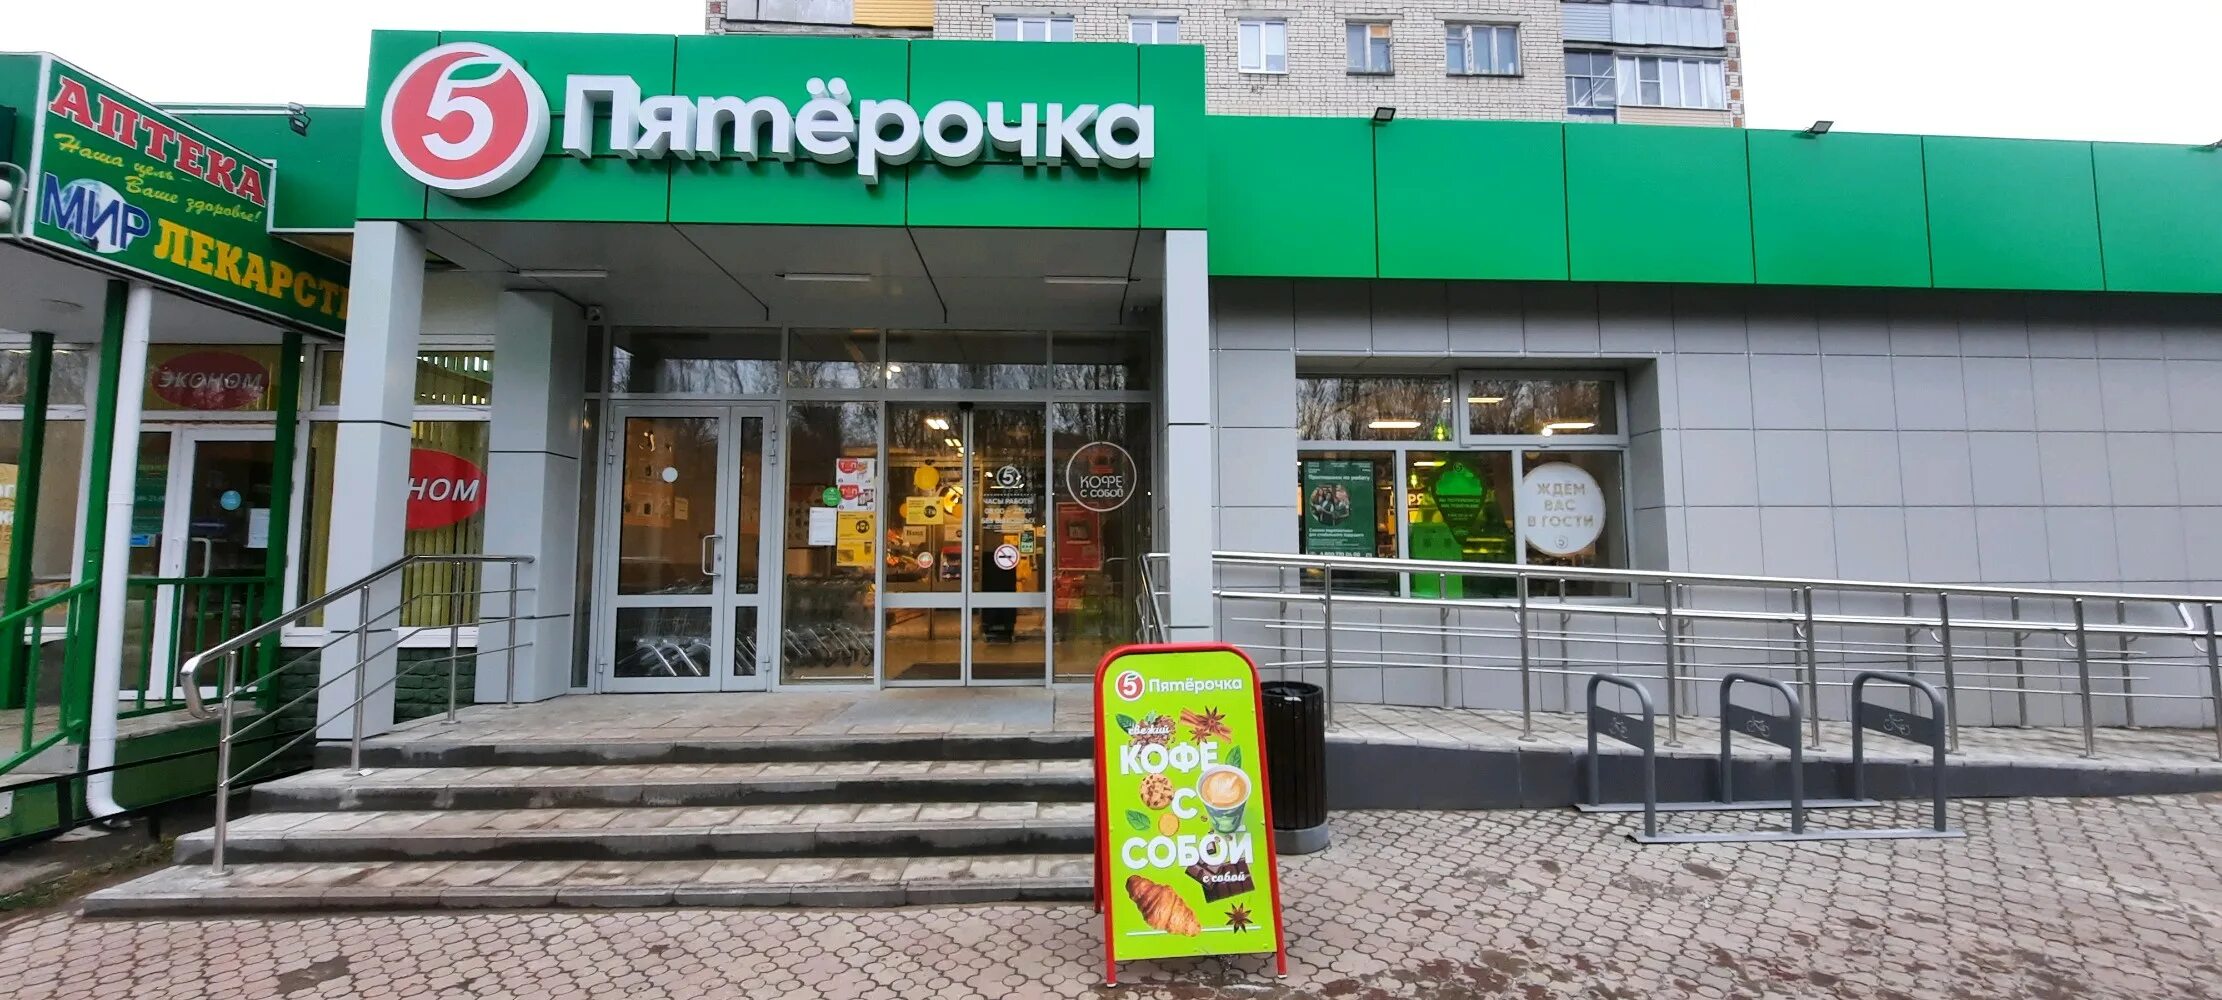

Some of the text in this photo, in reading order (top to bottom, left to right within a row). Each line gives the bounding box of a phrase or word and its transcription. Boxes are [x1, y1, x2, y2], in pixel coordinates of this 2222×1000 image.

[48, 75, 266, 207] АПТЕКА
[562, 73, 1155, 186] Пятёрочка
[53, 133, 124, 167] Наша
[133, 163, 174, 181] цель
[40, 172, 150, 251] МИР
[124, 175, 262, 223] Ваше здоровье!
[158, 370, 263, 389] ЭКОНОМ
[1080, 475, 1123, 488] КОФЕ
[1080, 488, 1124, 498] С СОБОЙ
[1544, 499, 1576, 511] ВАС
[1527, 515, 1594, 527] В ГОСТИ
[1123, 672, 1243, 696] 5 Пятёрочка
[1128, 724, 1171, 736] свежий
[1120, 741, 1219, 775] КОФЕ
[1171, 787, 1198, 819] С
[1121, 825, 1254, 870] СОБОЙ
[1211, 871, 1247, 883] собой
